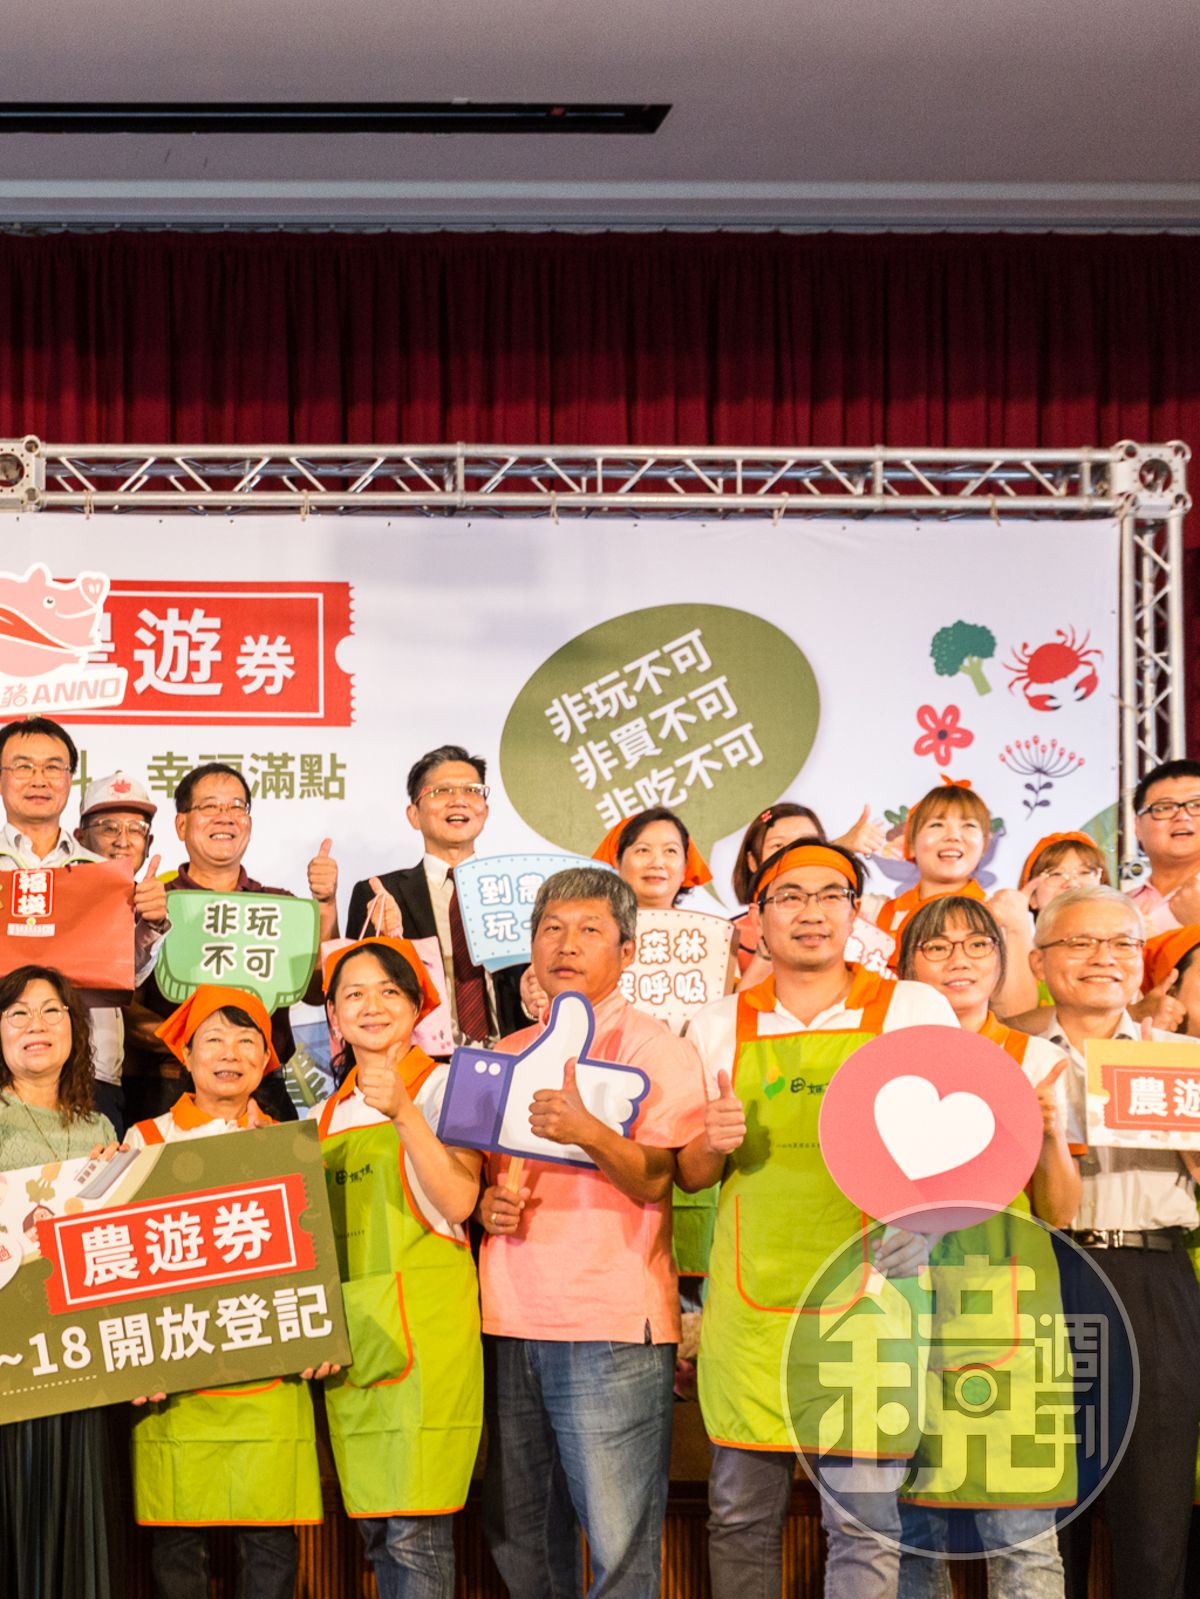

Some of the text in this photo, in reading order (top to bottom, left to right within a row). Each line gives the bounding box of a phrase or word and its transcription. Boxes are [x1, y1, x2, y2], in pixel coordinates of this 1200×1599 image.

[544, 628, 712, 744] 非玩不可
[570, 675, 738, 791] 非買不可
[146, 752, 347, 800] 幸滿點
[595, 722, 764, 830] 非吃不可
[202, 899, 282, 938] 非玩
[638, 928, 708, 964] 森林
[201, 941, 279, 983] 不可
[83, 1200, 273, 1288] 農遊券
